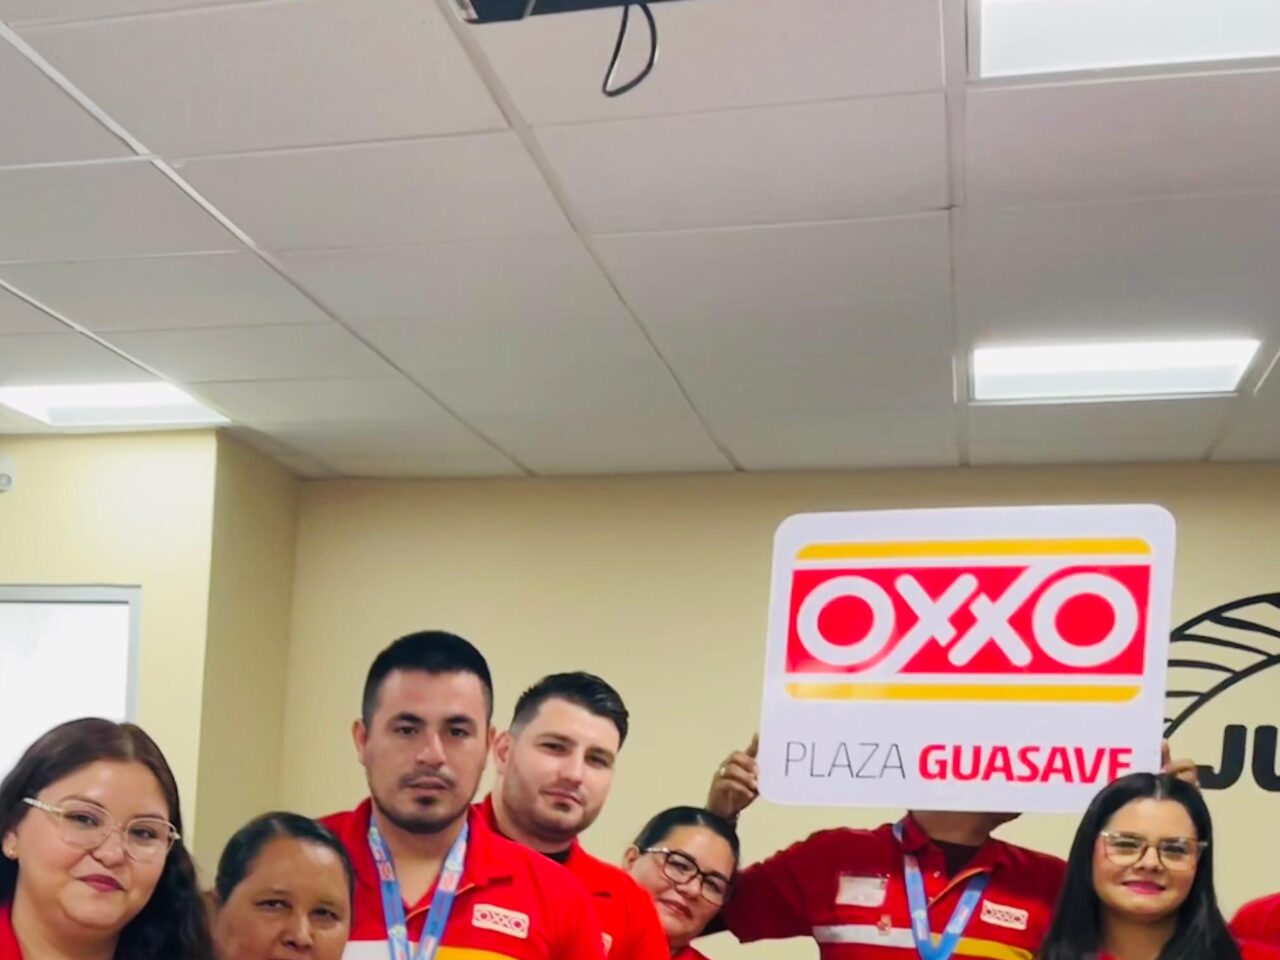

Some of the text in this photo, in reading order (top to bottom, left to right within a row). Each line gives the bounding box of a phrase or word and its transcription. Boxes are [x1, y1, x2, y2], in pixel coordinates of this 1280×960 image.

[796, 570, 1139, 672] OXXO
[784, 741, 1133, 784] PLAZA GUASAVE
[476, 908, 527, 933] OXXO
